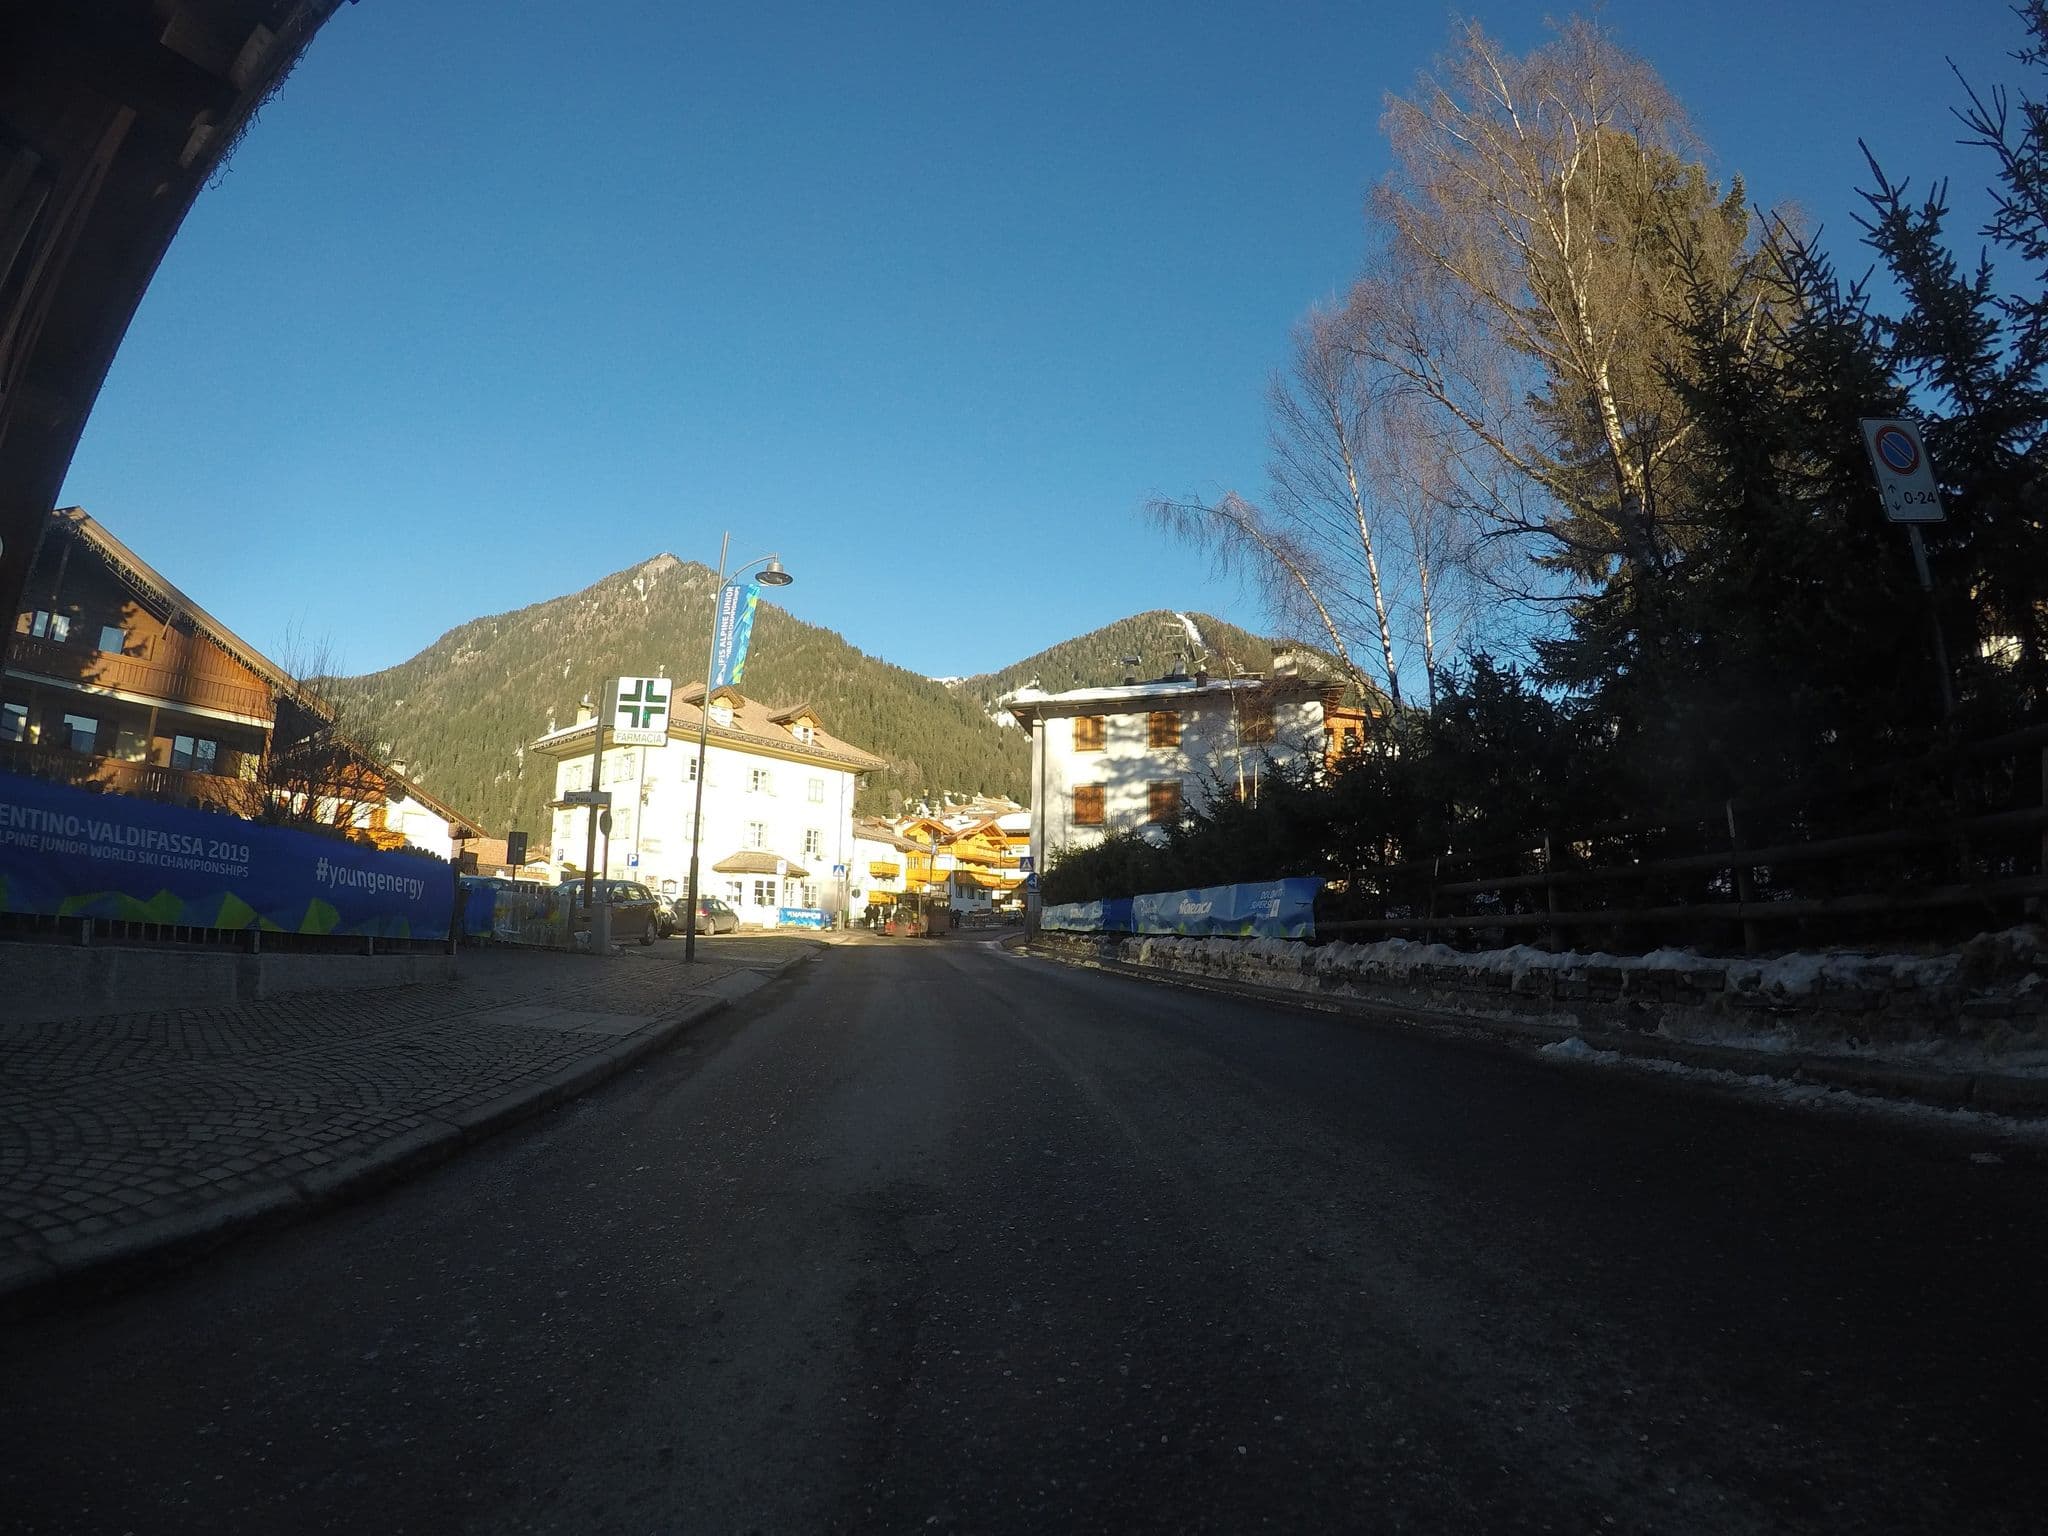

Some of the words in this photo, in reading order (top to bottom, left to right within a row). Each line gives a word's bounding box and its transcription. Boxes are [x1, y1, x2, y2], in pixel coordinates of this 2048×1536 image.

[1903, 491, 1936, 505] 0-24
[723, 586, 735, 616] JUNIOR
[720, 616, 729, 648] ALPINE
[616, 732, 662, 744] FARMACIA
[39, 836, 88, 856] JUNIOR
[91, 846, 136, 863] WORLD
[138, 852, 158, 866] SKI
[160, 854, 249, 878] CHAMPIONSHIPS
[208, 840, 250, 863] 2019
[316, 857, 425, 900] #youngenergy
